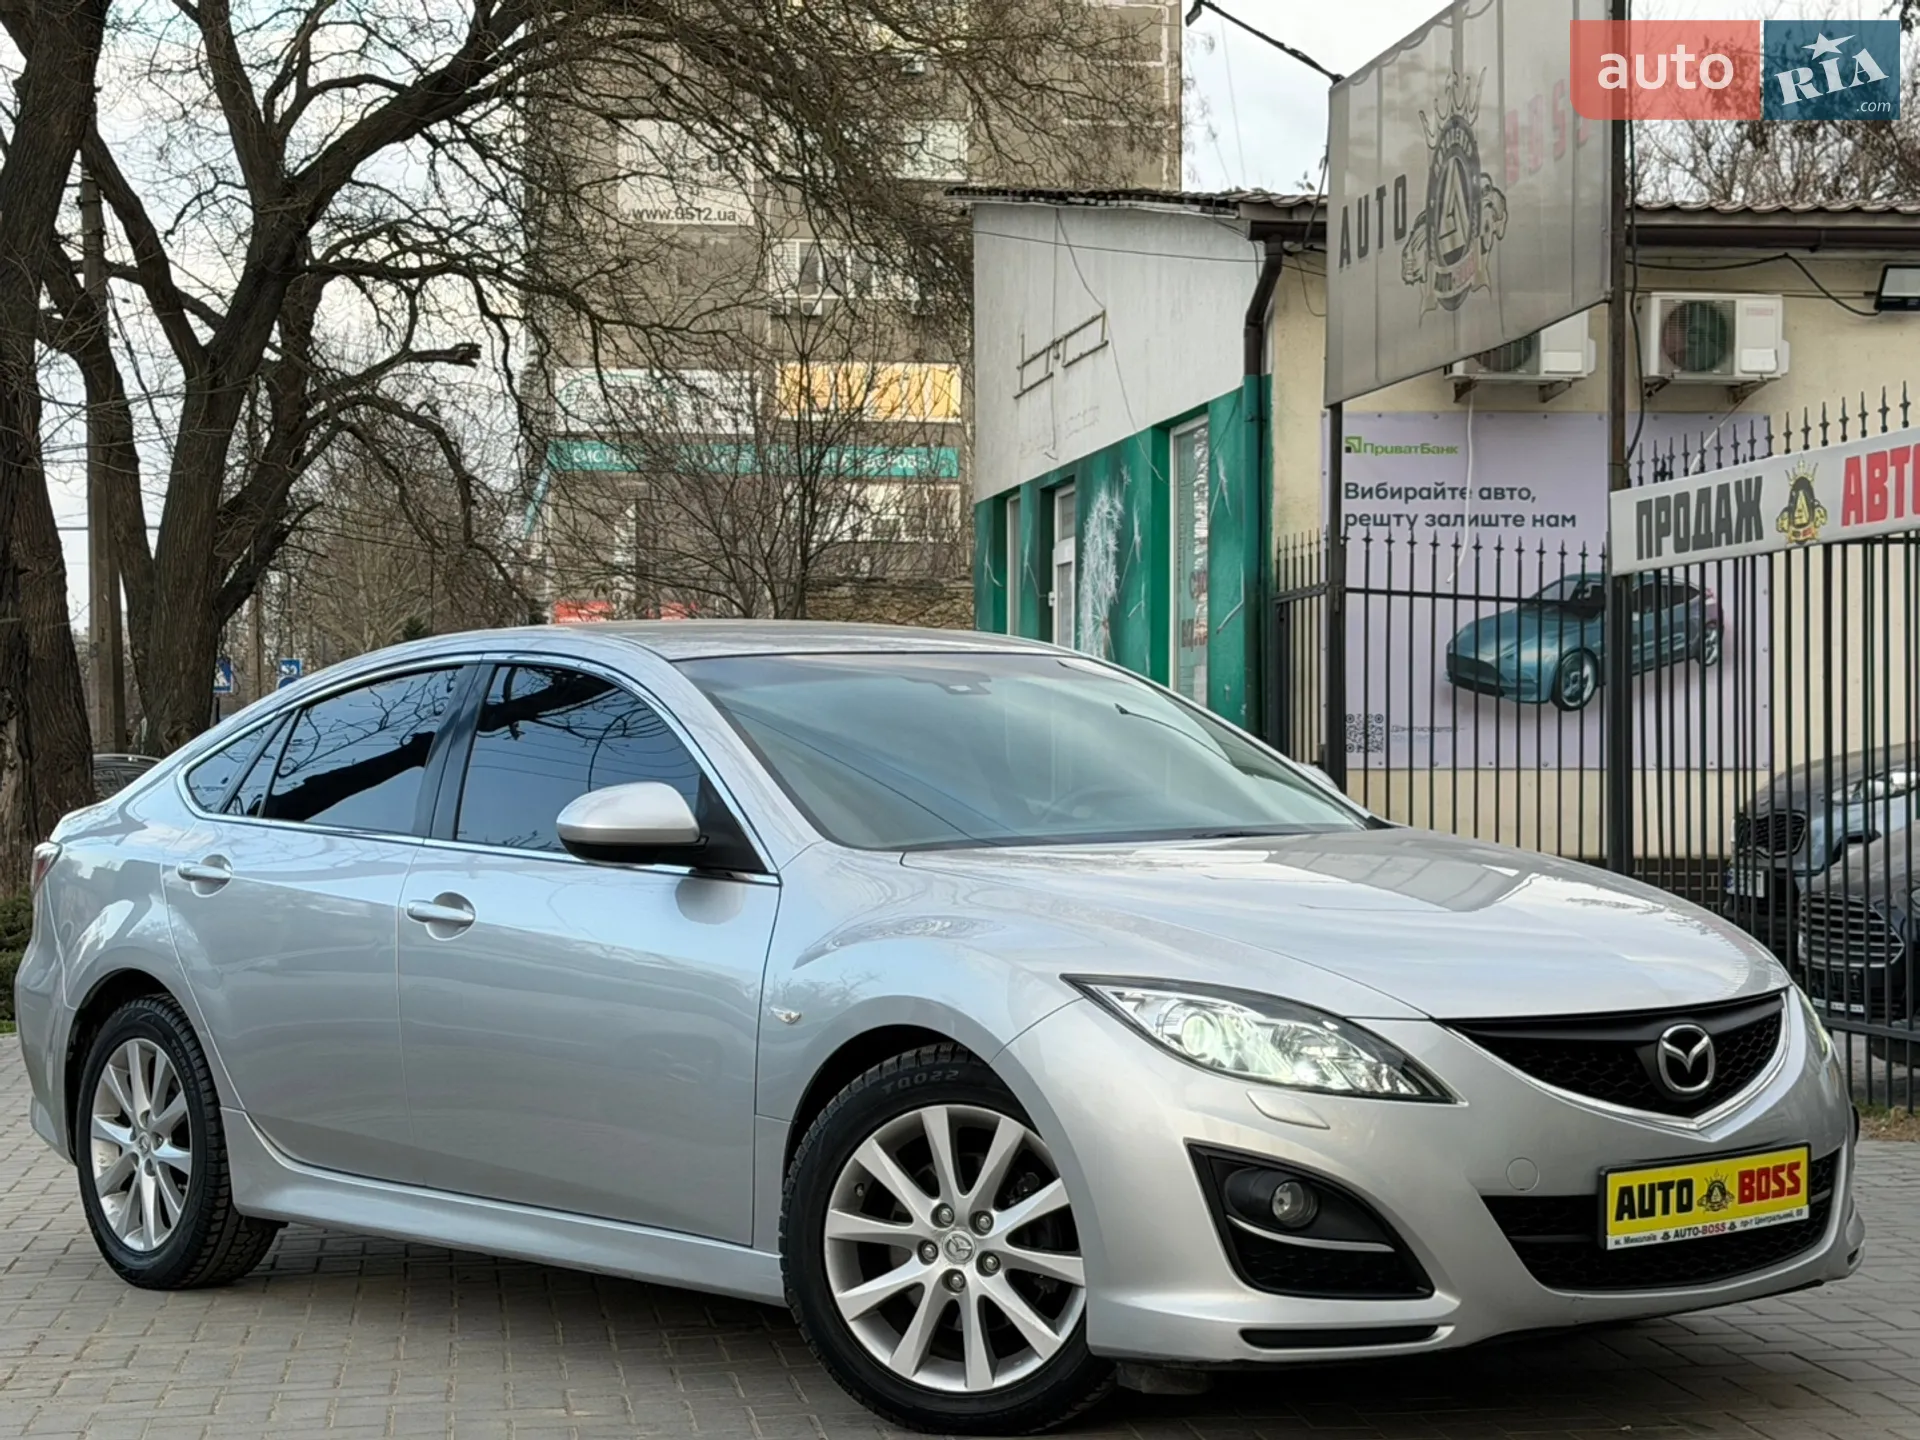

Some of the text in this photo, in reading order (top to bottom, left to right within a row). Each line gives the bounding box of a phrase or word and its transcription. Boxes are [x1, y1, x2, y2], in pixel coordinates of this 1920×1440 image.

[632, 206, 737, 222] www.0512.ua
[1338, 173, 1407, 270] AUTO
[1363, 441, 1458, 457] ПриватБанк
[1344, 481, 1537, 504] Вибирайте авто,
[1344, 513, 1577, 530] решту залиште нам
[1636, 475, 1764, 561] ПРОДАЖ
[1615, 1161, 1801, 1222] AUTO BOSS
[1673, 1221, 1727, 1239] AUTO-BOSS
